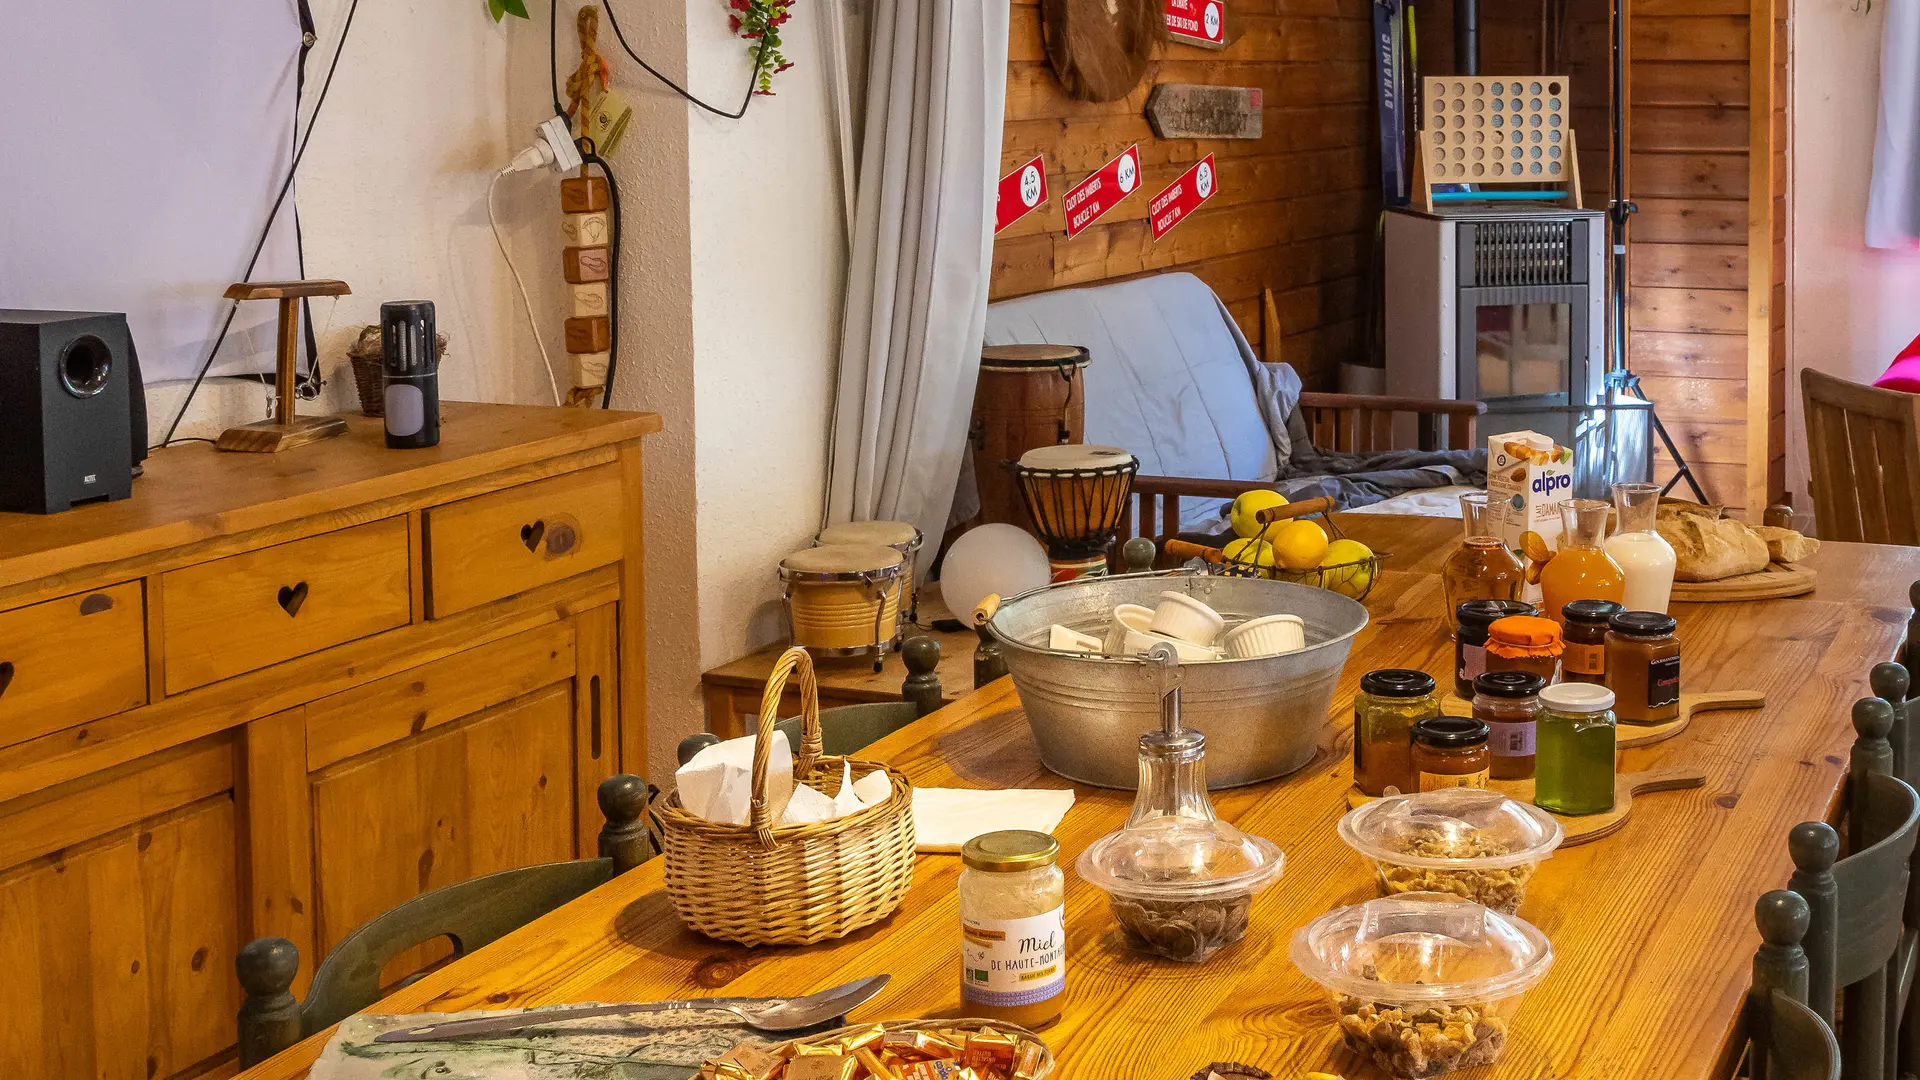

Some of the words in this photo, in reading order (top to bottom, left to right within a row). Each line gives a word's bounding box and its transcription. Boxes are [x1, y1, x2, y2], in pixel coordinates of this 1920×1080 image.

[1205, 13, 1209, 24] 2
[1382, 33, 1394, 110] DYNAMIC
[1024, 170, 1036, 186] 4.5
[1119, 172, 1123, 184] 6
[1124, 166, 1135, 180] KM
[1199, 166, 1208, 182] 6.5
[1025, 185, 1038, 201] KM
[1200, 180, 1210, 193] KM
[1066, 193, 1078, 212] CLOT
[1076, 188, 1086, 204] DES
[1160, 194, 1169, 209] DES
[1073, 206, 1090, 229] BOUCLE
[1157, 211, 1172, 232] BOUCLE
[1532, 471, 1571, 496] alpro
[1018, 930, 1056, 954] Miel
[991, 959, 1002, 971] DE
